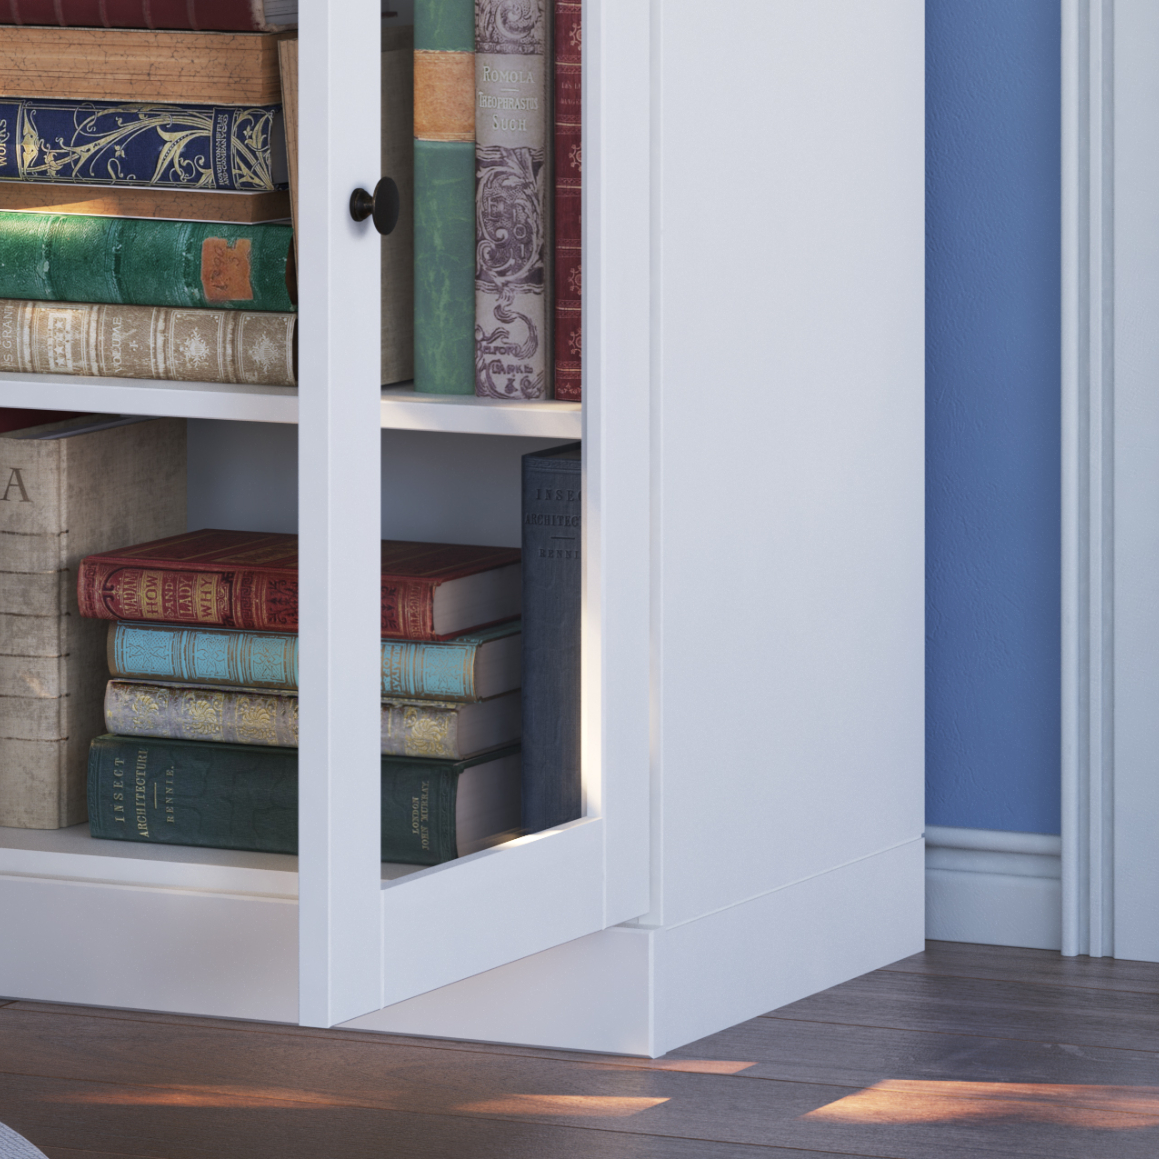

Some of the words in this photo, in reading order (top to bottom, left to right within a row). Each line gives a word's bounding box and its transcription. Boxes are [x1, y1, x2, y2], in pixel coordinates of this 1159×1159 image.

[482, 65, 536, 84] ROMOLA
[478, 91, 539, 111] THEOPHRASTUS
[492, 113, 528, 132] SUCH
[0, 466, 35, 504] A
[525, 512, 581, 528] ARCHITEC
[145, 574, 159, 615] HOW
[165, 582, 175, 610] AND
[179, 578, 193, 616] LADY
[200, 577, 214, 619] WHY
[113, 757, 126, 823] INSECT
[411, 796, 420, 835] LONDON
